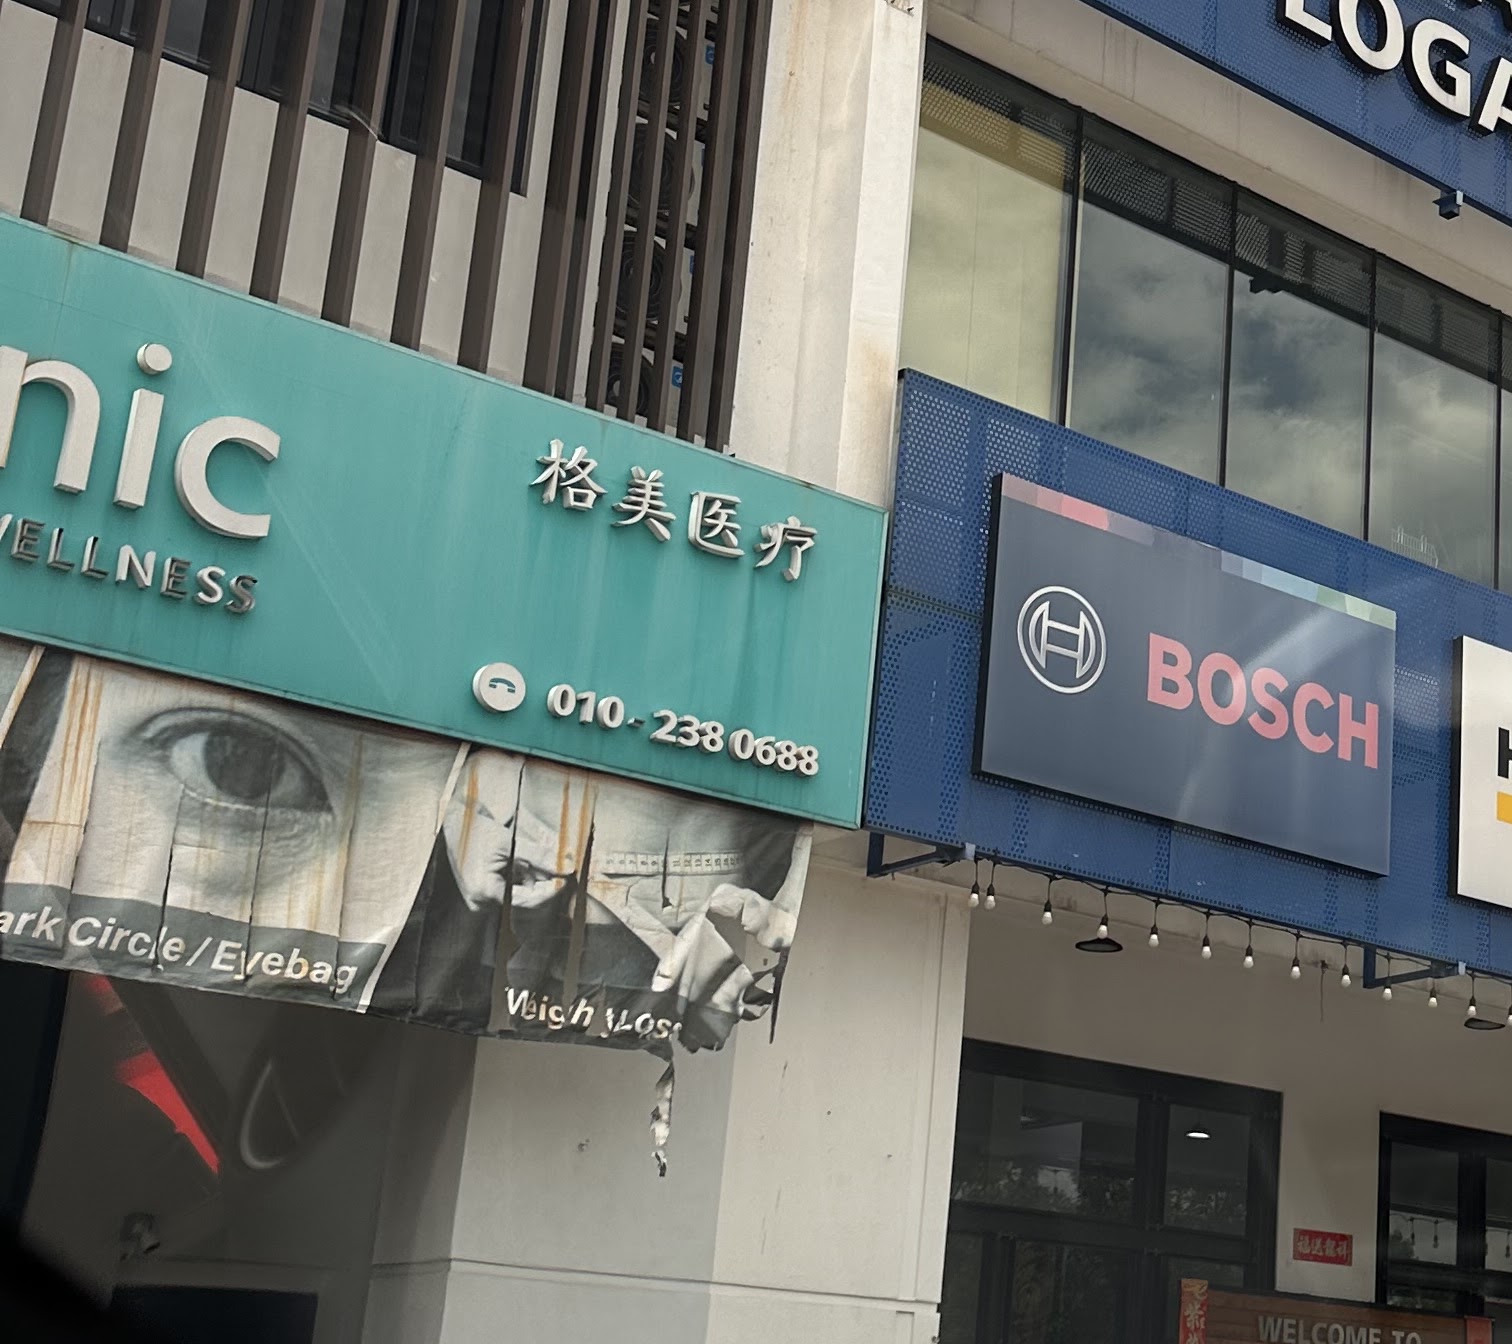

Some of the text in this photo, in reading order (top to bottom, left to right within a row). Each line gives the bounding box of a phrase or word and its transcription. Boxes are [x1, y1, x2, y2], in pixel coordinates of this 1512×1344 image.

[0, 342, 281, 540] nic
[530, 438, 818, 582] 格美医疗
[729, 729, 820, 777] 0688
[1147, 632, 1379, 769] BOSCH
[68, 916, 186, 963] Circle
[211, 939, 358, 994] Eyebag
